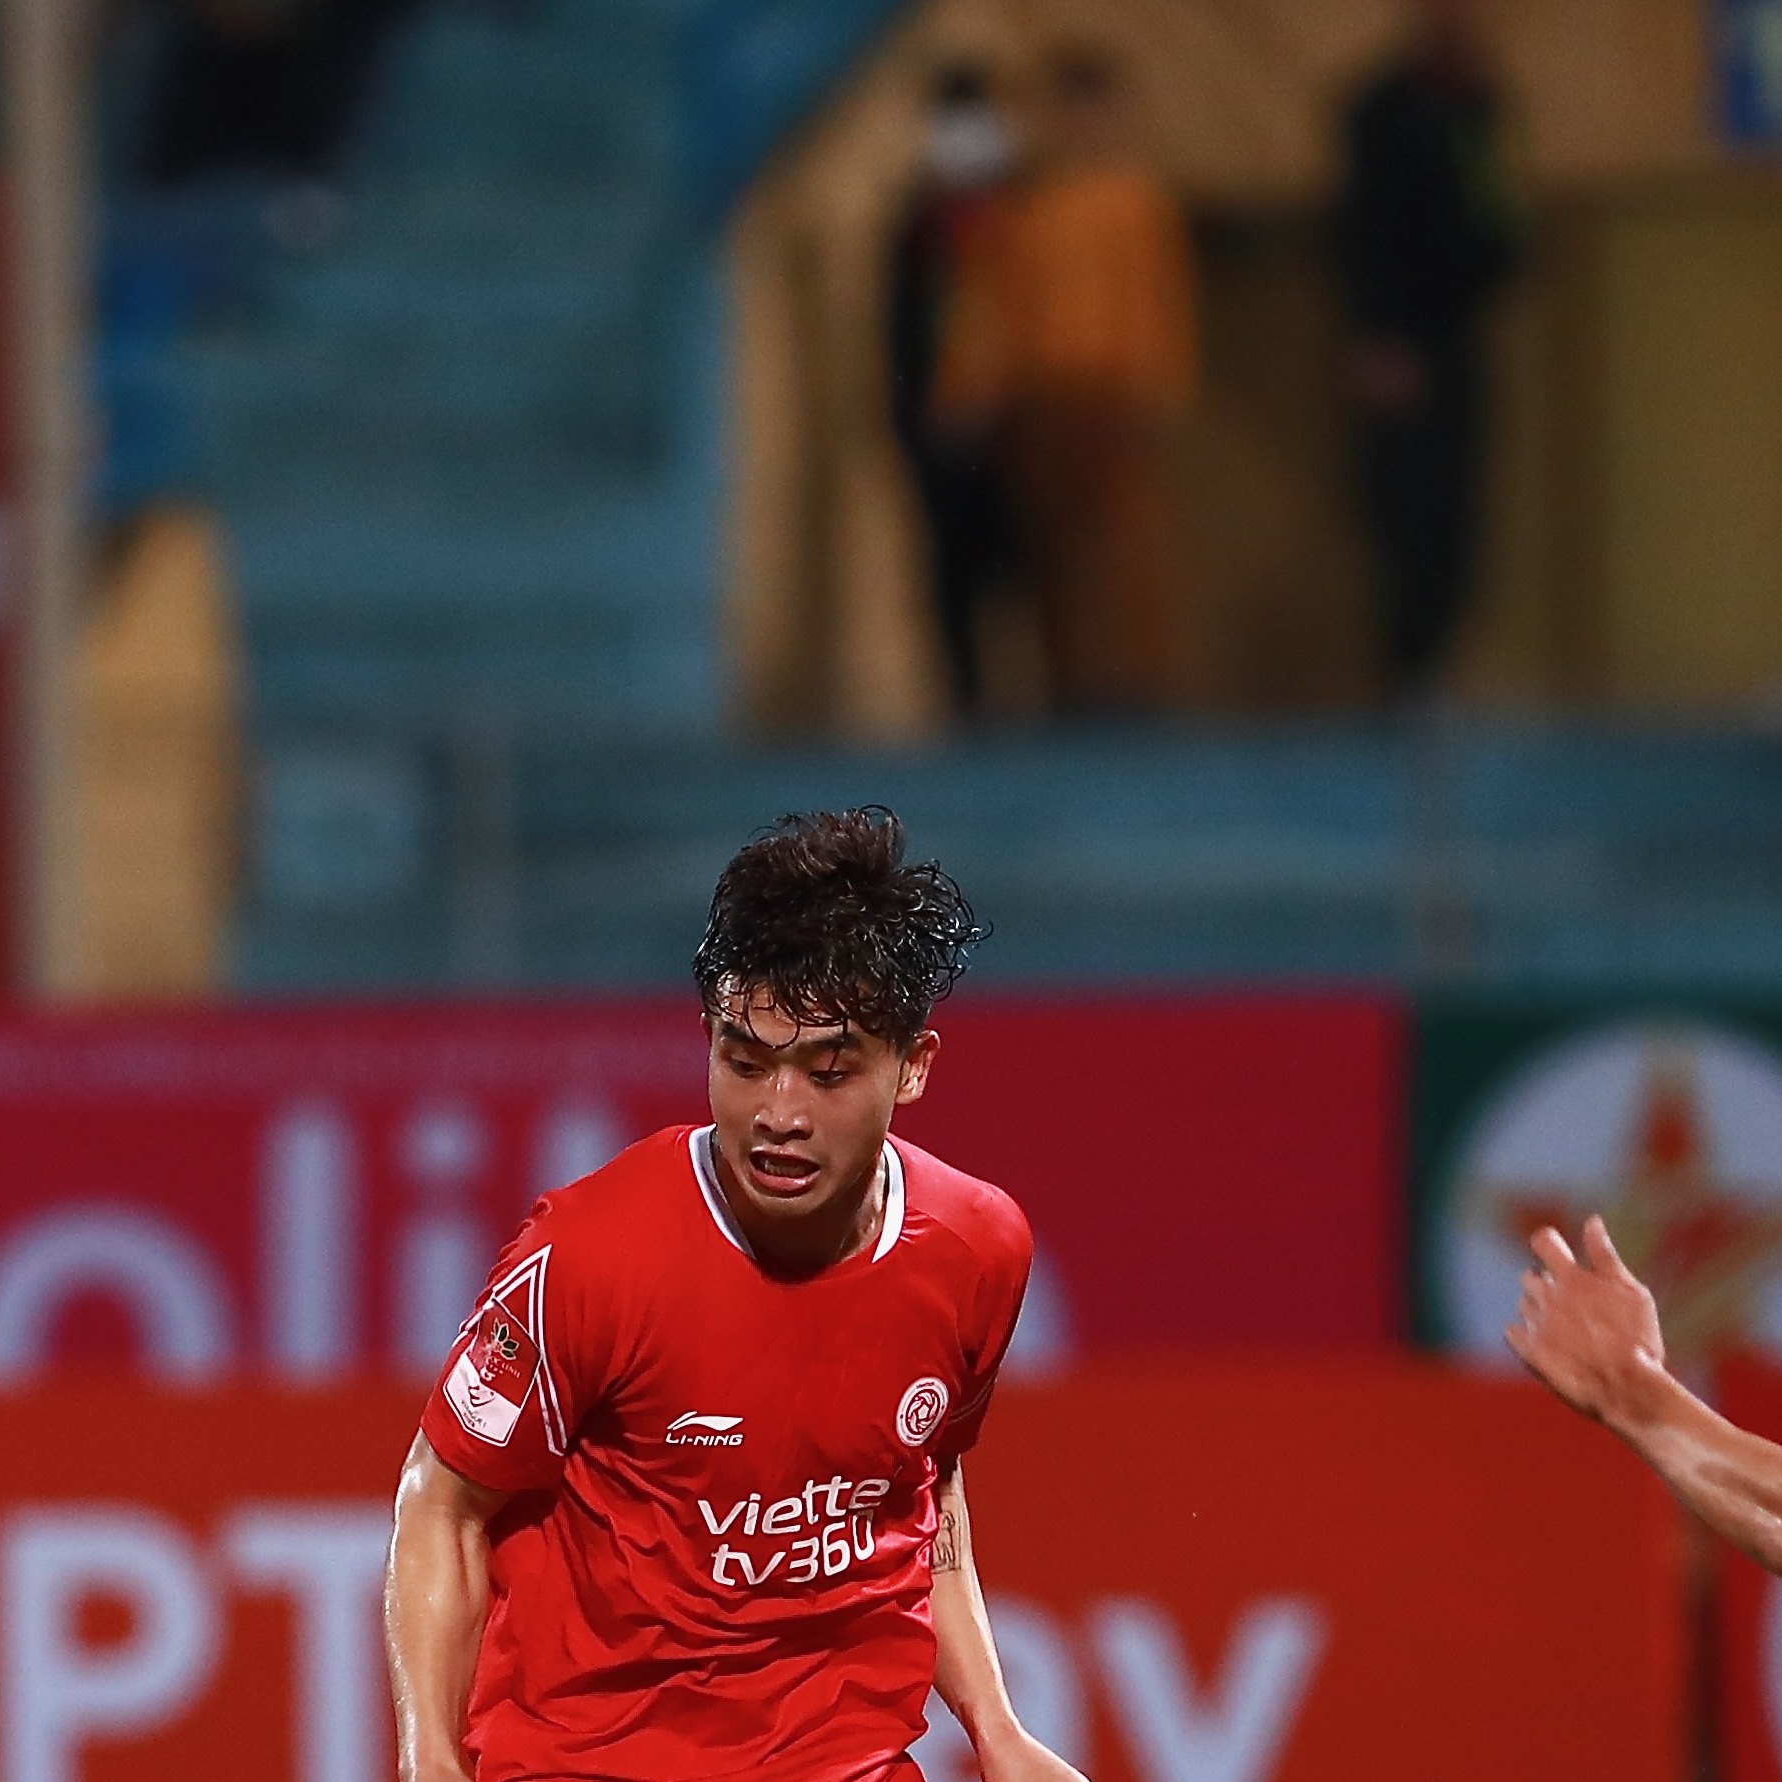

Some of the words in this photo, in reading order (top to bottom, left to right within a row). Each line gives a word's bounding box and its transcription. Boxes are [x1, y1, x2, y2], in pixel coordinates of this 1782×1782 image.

[665, 1433, 744, 1446] LI-NING
[697, 1474, 891, 1536] viette
[711, 1509, 875, 1587] tv360
